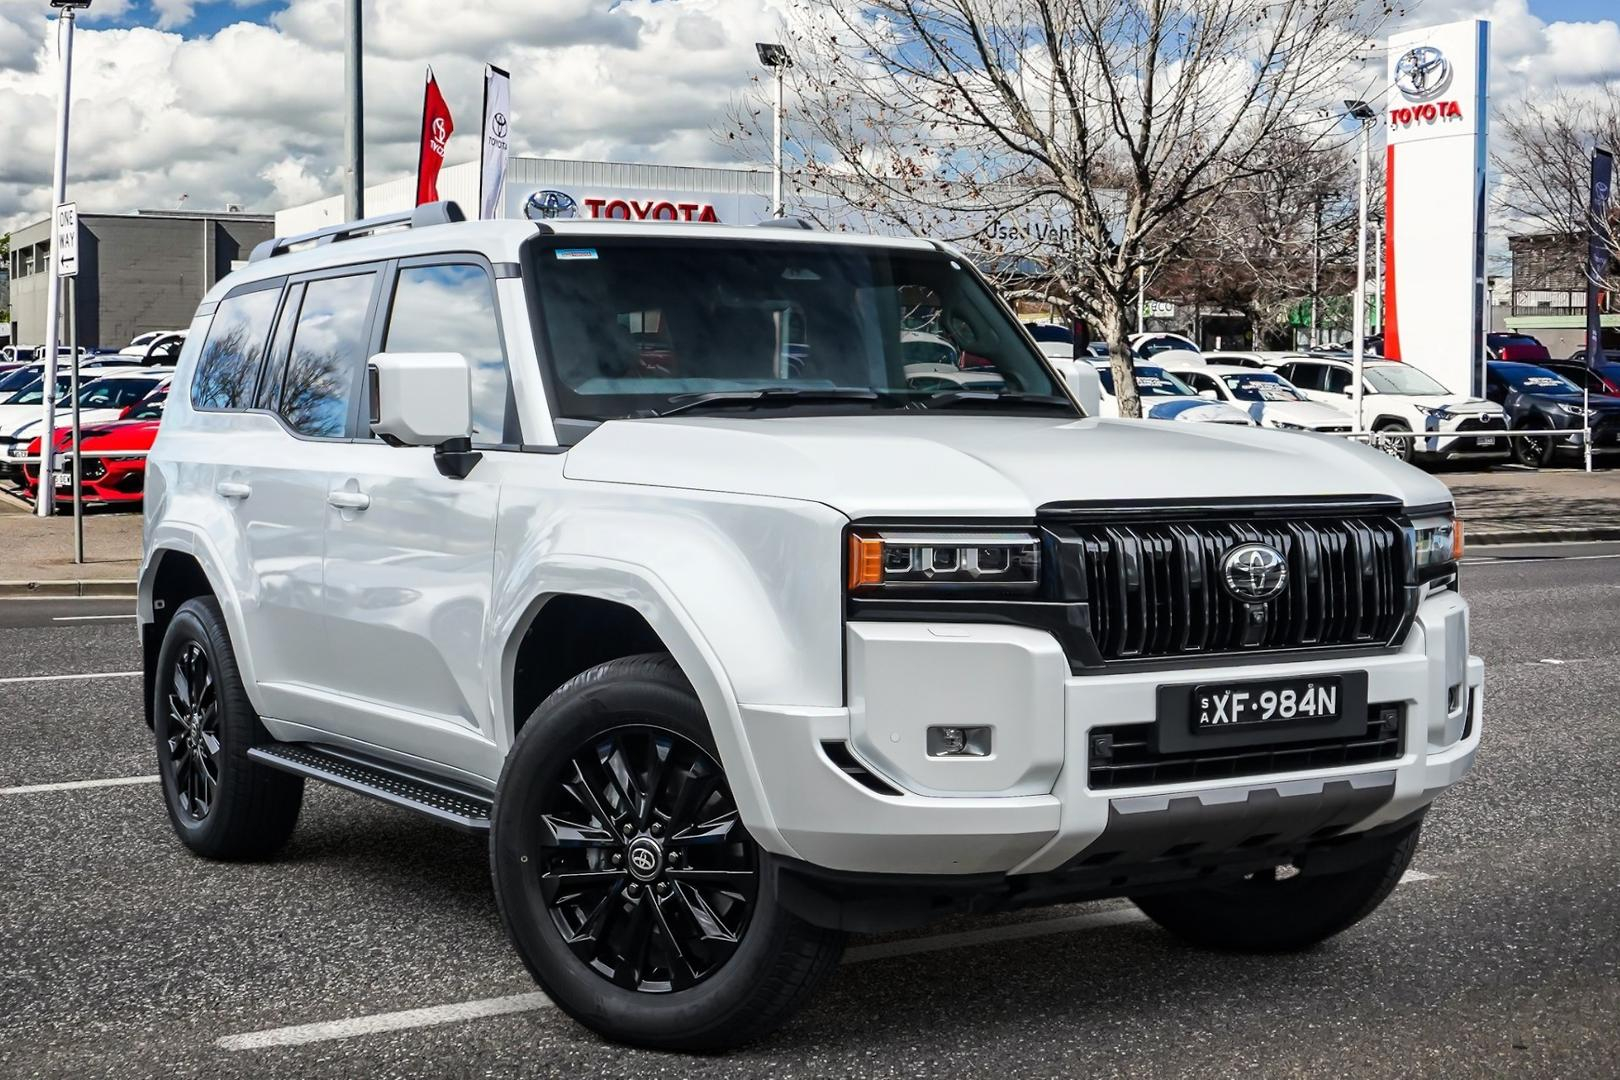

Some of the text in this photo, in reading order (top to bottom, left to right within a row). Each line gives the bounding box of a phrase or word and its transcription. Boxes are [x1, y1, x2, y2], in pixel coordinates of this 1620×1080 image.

[1390, 101, 1462, 125] TOYOTA
[488, 136, 508, 150] TOYOTA
[60, 209, 74, 228] ONE
[584, 198, 719, 223] TOYOTA
[60, 231, 75, 249] WAY
